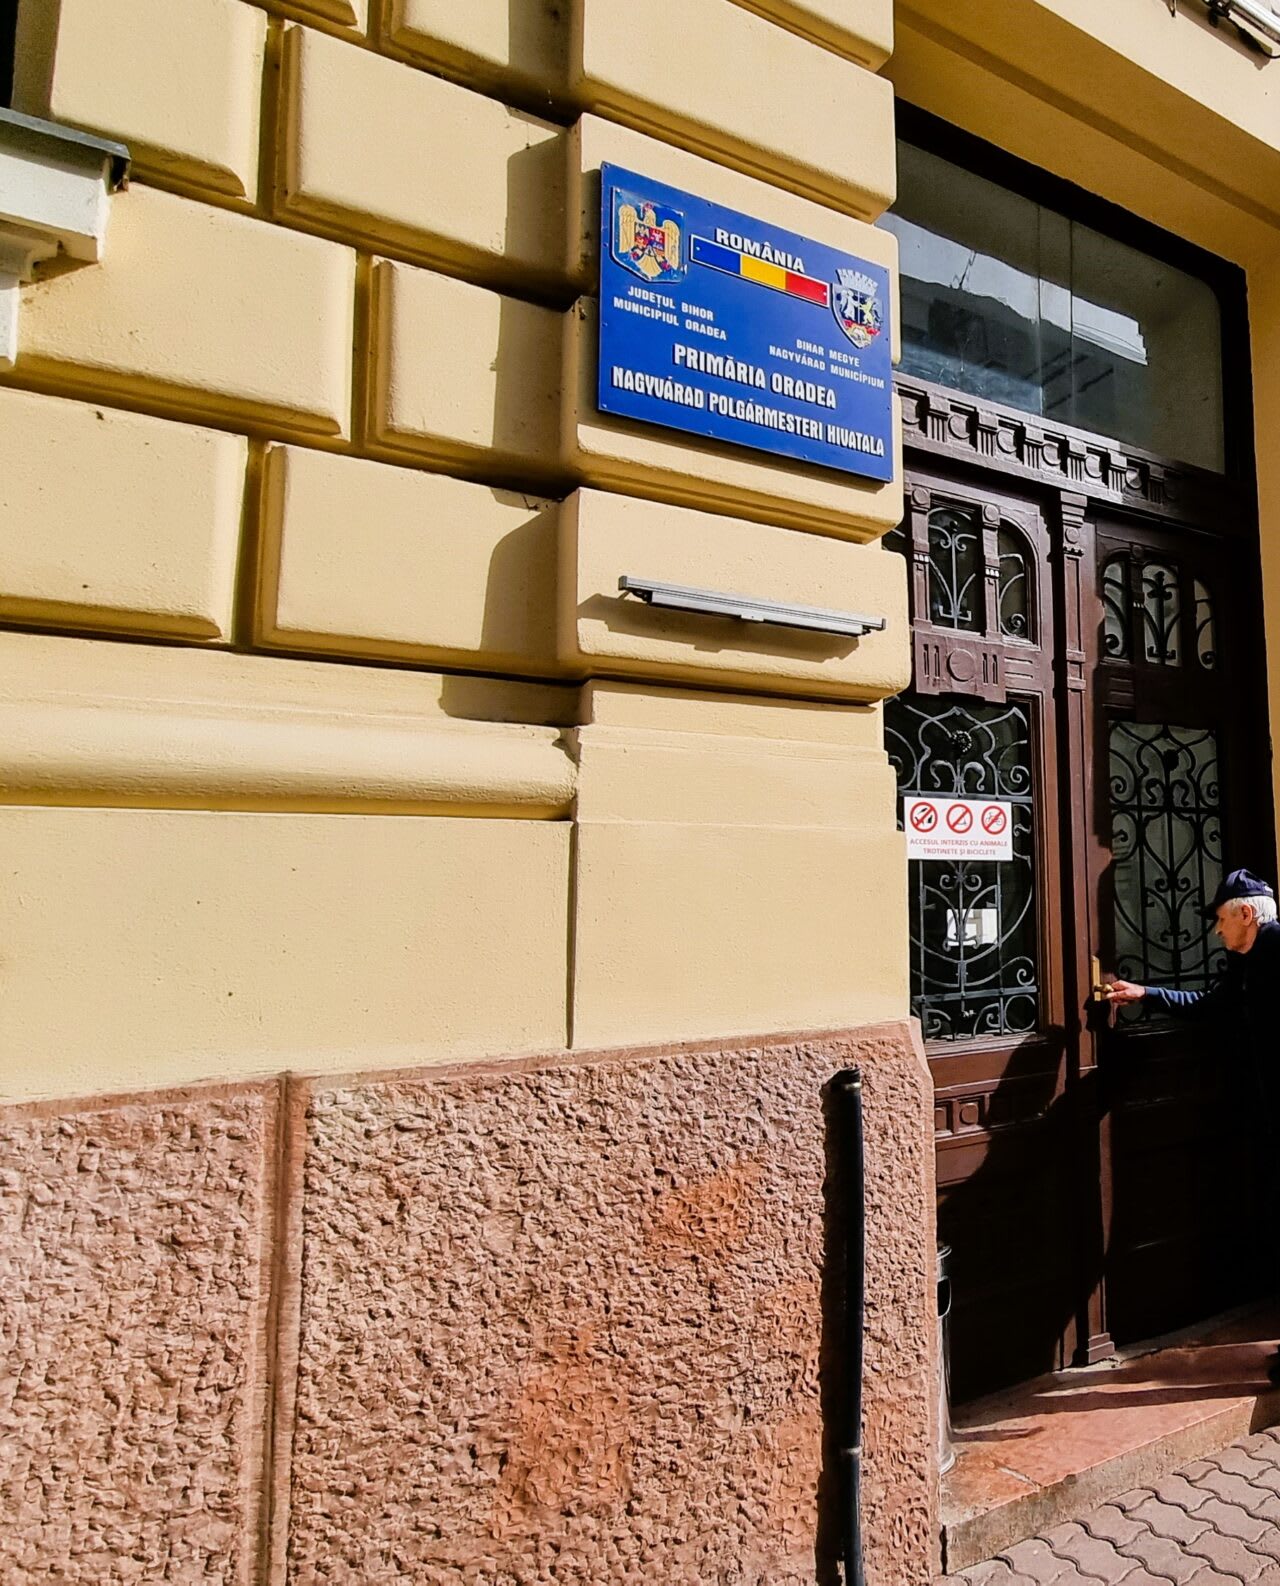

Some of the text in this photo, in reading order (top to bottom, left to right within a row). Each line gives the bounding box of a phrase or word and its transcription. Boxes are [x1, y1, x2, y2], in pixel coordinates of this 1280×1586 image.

[716, 227, 805, 273] ROMÂNIA
[613, 296, 727, 340] MUNICIPIUL ORADEA
[628, 285, 714, 321] JUDEȚUL BIHOR
[769, 345, 885, 389] NAGYVÁRAD MUNICÍPIUM
[796, 339, 860, 367] BIHAR MEGYE
[673, 342, 837, 409] PRIMĂRIA ORADEA
[708, 391, 823, 440] POLGÁRMESTERI
[827, 424, 885, 457] HIVATALA
